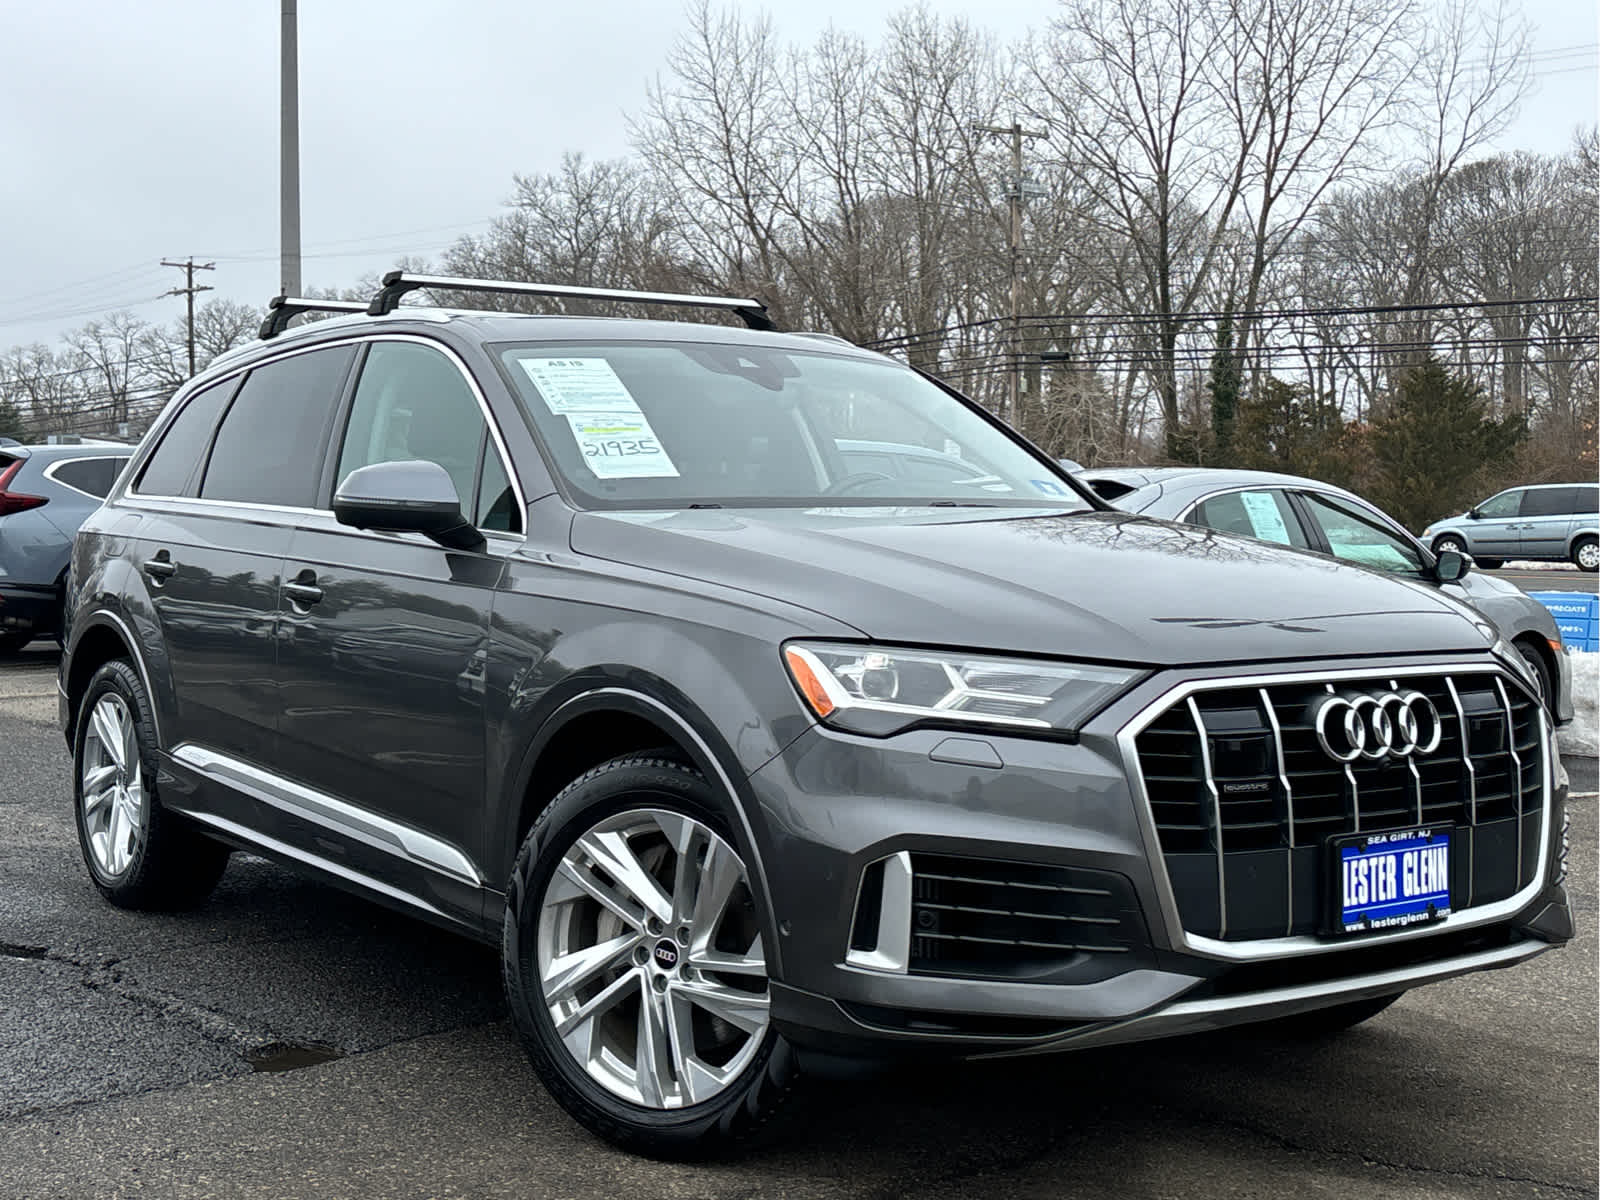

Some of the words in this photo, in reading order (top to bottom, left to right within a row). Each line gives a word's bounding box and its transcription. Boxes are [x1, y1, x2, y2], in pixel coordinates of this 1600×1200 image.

[583, 440, 660, 457] 21935
[1367, 834, 1388, 845] SEA
[1389, 831, 1416, 842] GIRT,
[1418, 830, 1431, 838] NJ
[1343, 854, 1397, 907] LESTER
[1403, 847, 1448, 897] GLENN
[1371, 911, 1429, 929] lesterglenn
